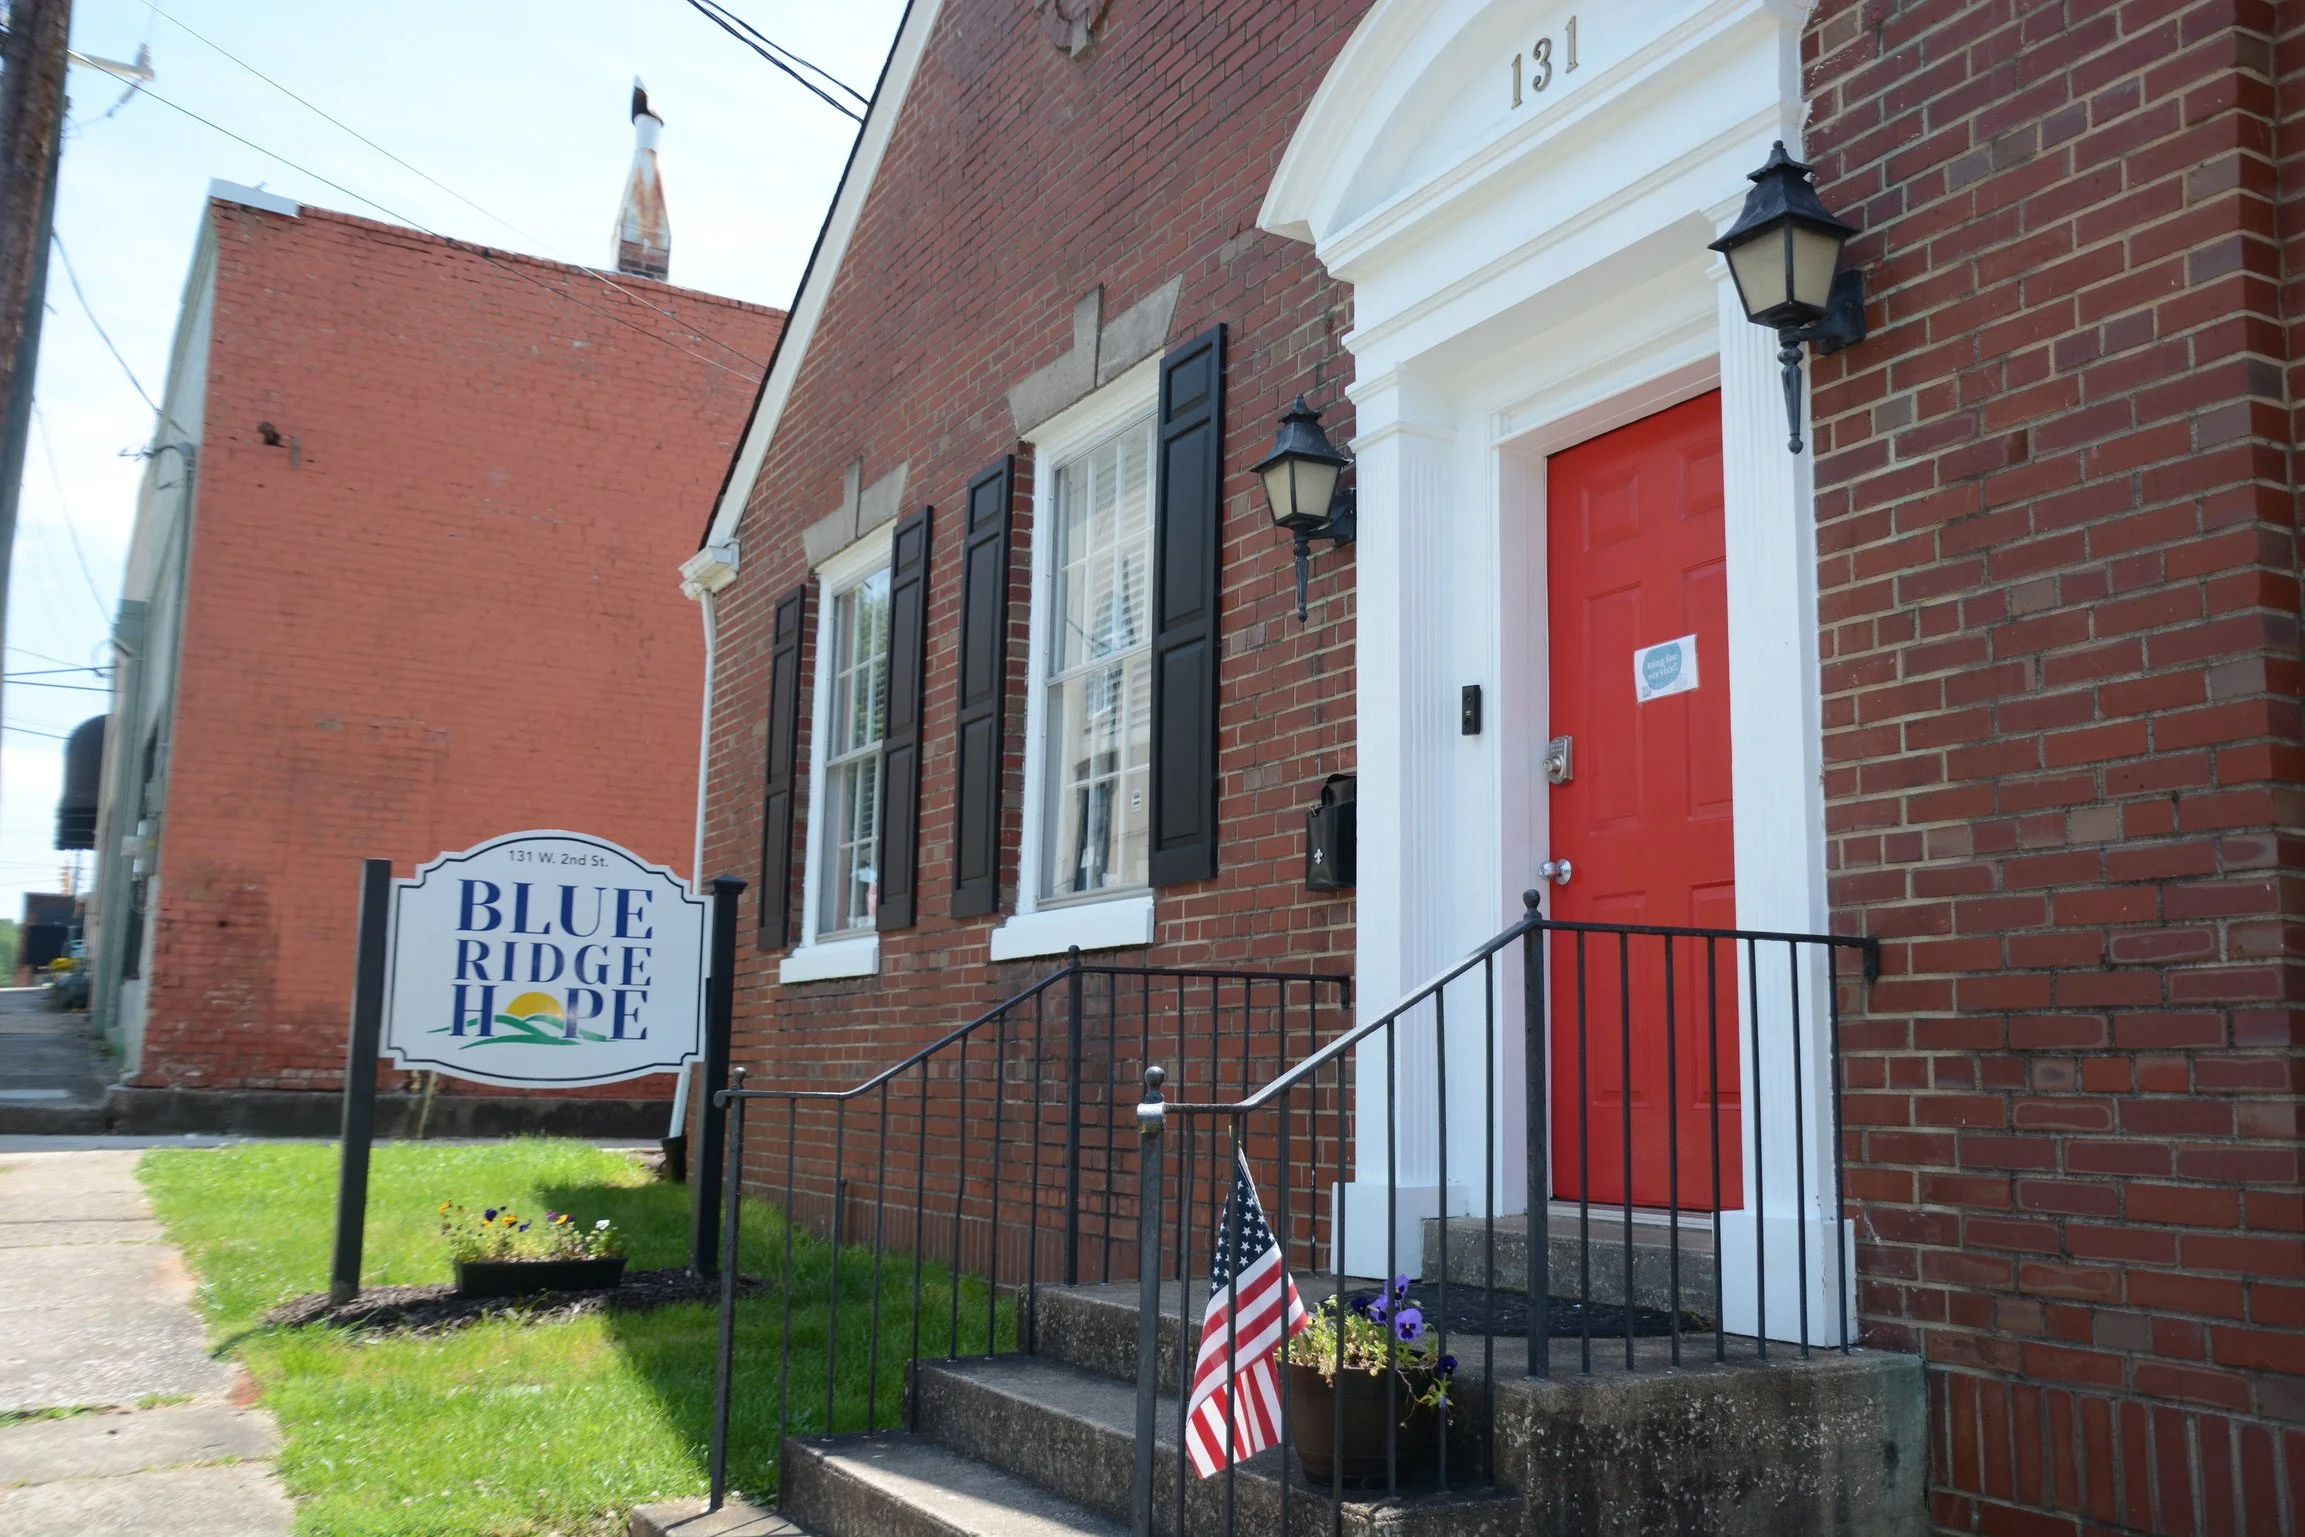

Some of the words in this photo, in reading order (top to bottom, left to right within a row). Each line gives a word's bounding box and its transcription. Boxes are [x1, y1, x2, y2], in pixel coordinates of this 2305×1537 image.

[1511, 15, 1579, 110] 131
[508, 850, 533, 862] 131
[538, 852, 556, 864] W.
[560, 853, 587, 866] 2nd
[591, 855, 609, 867] St.
[455, 879, 653, 939] BLUE
[453, 938, 652, 987] RIDGE
